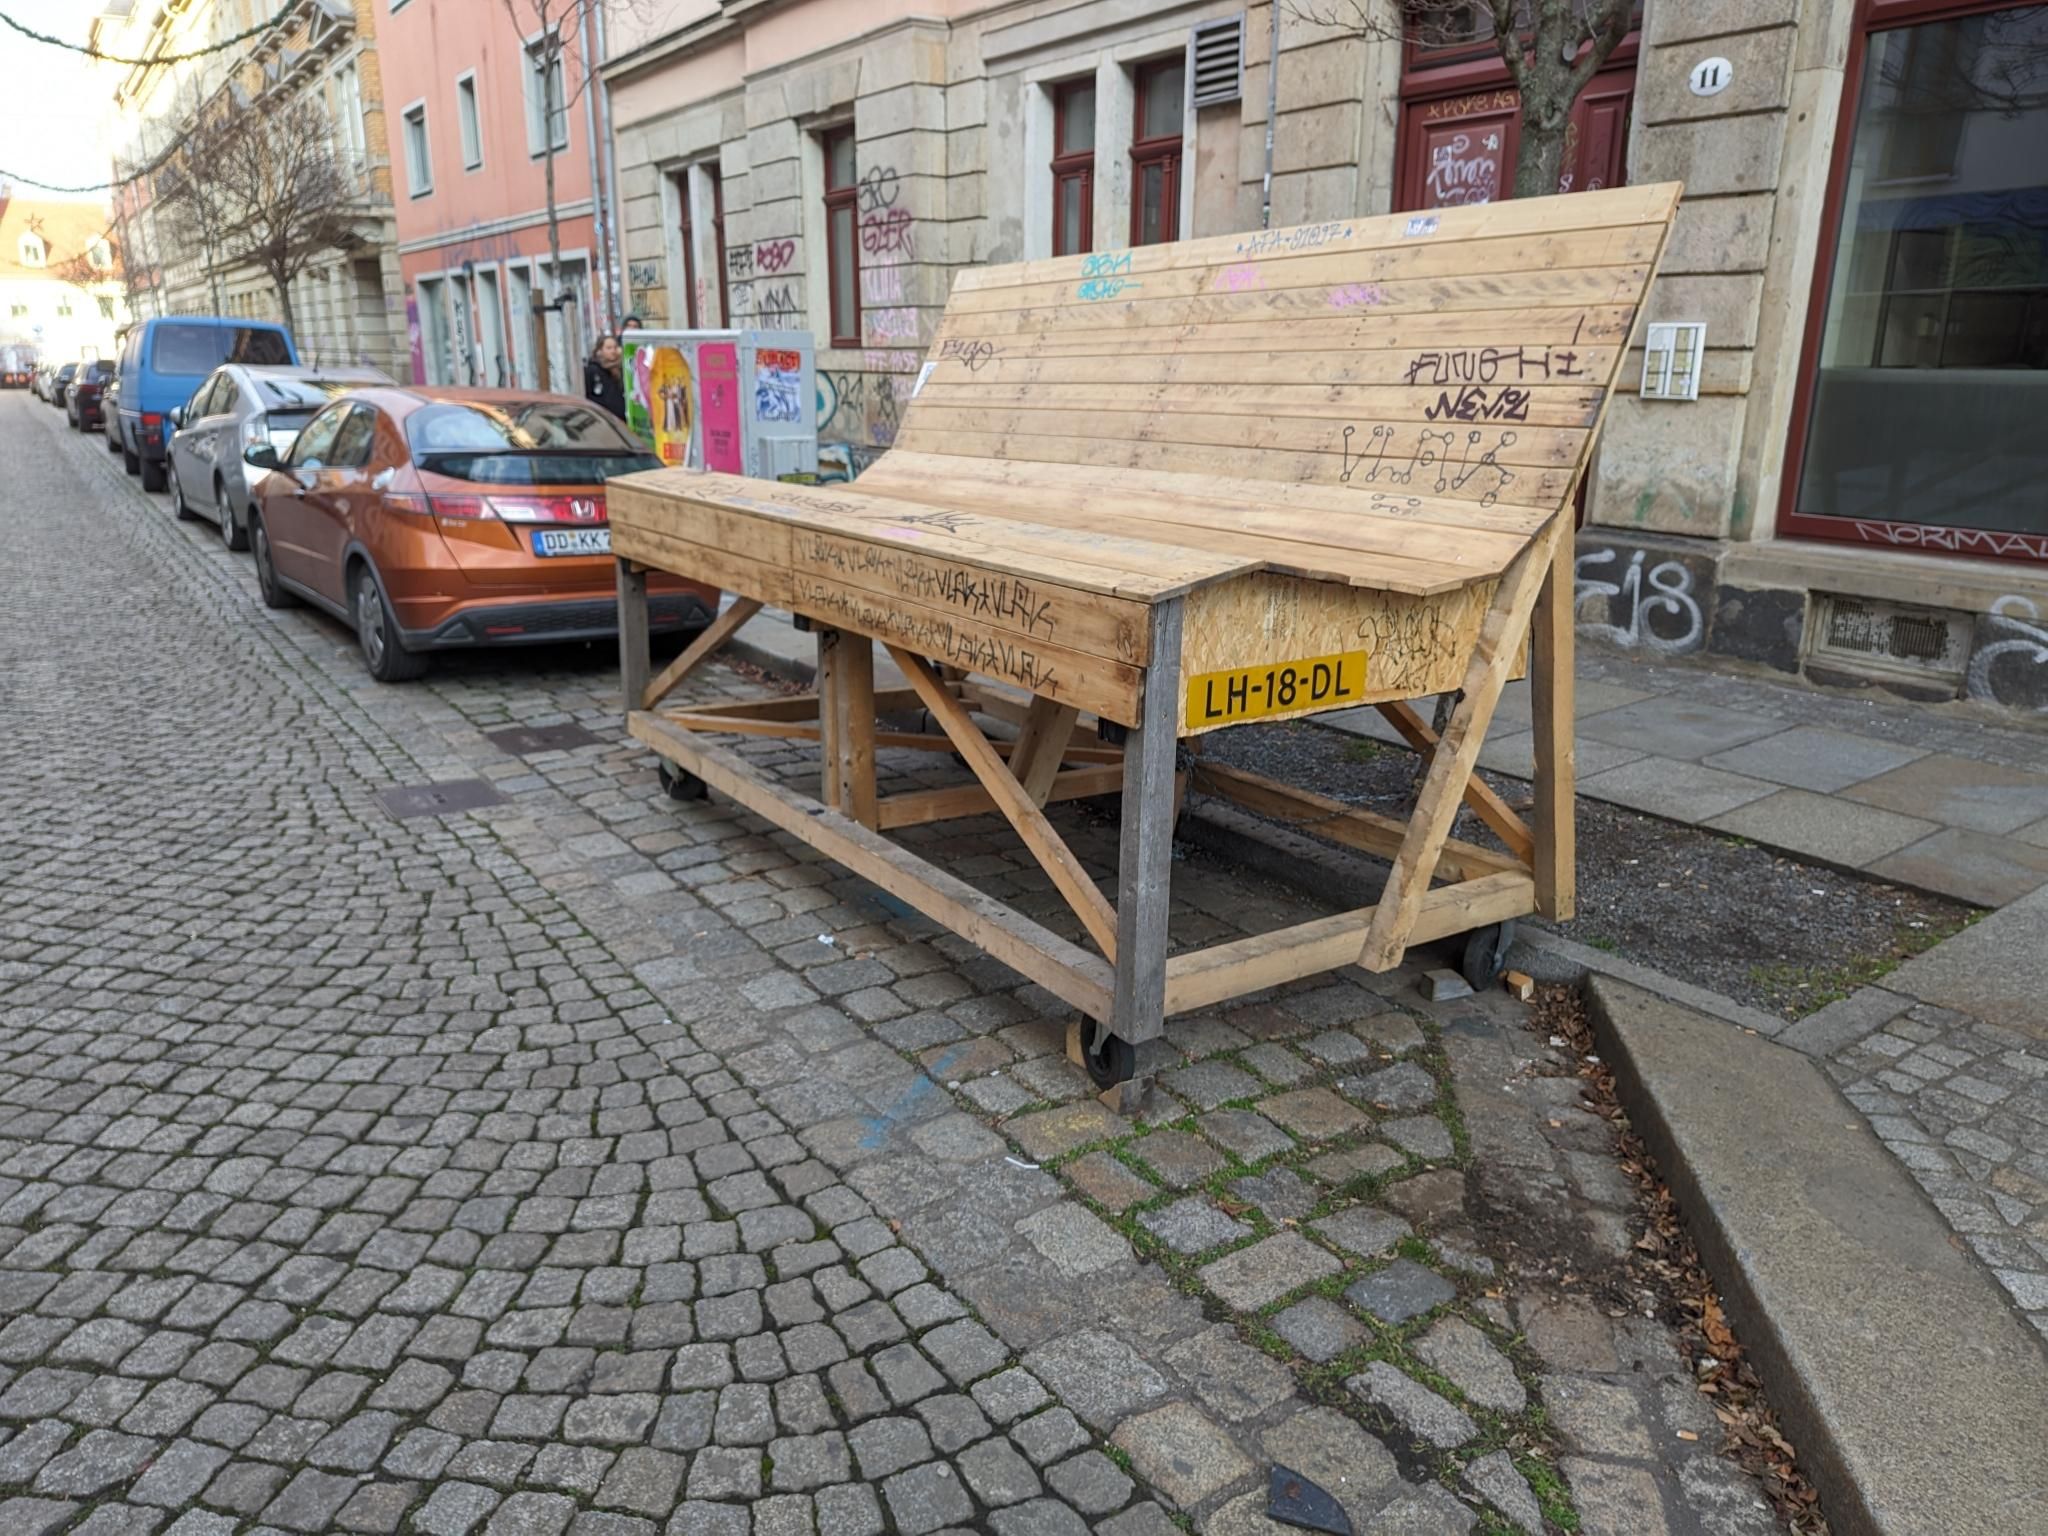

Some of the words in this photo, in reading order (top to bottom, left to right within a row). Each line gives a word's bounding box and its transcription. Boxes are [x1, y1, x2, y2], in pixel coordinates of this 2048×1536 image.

[1699, 64, 1720, 89] 11
[544, 532, 569, 550] DD
[579, 531, 601, 548] KK
[1205, 660, 1350, 718] LH-18-DL
